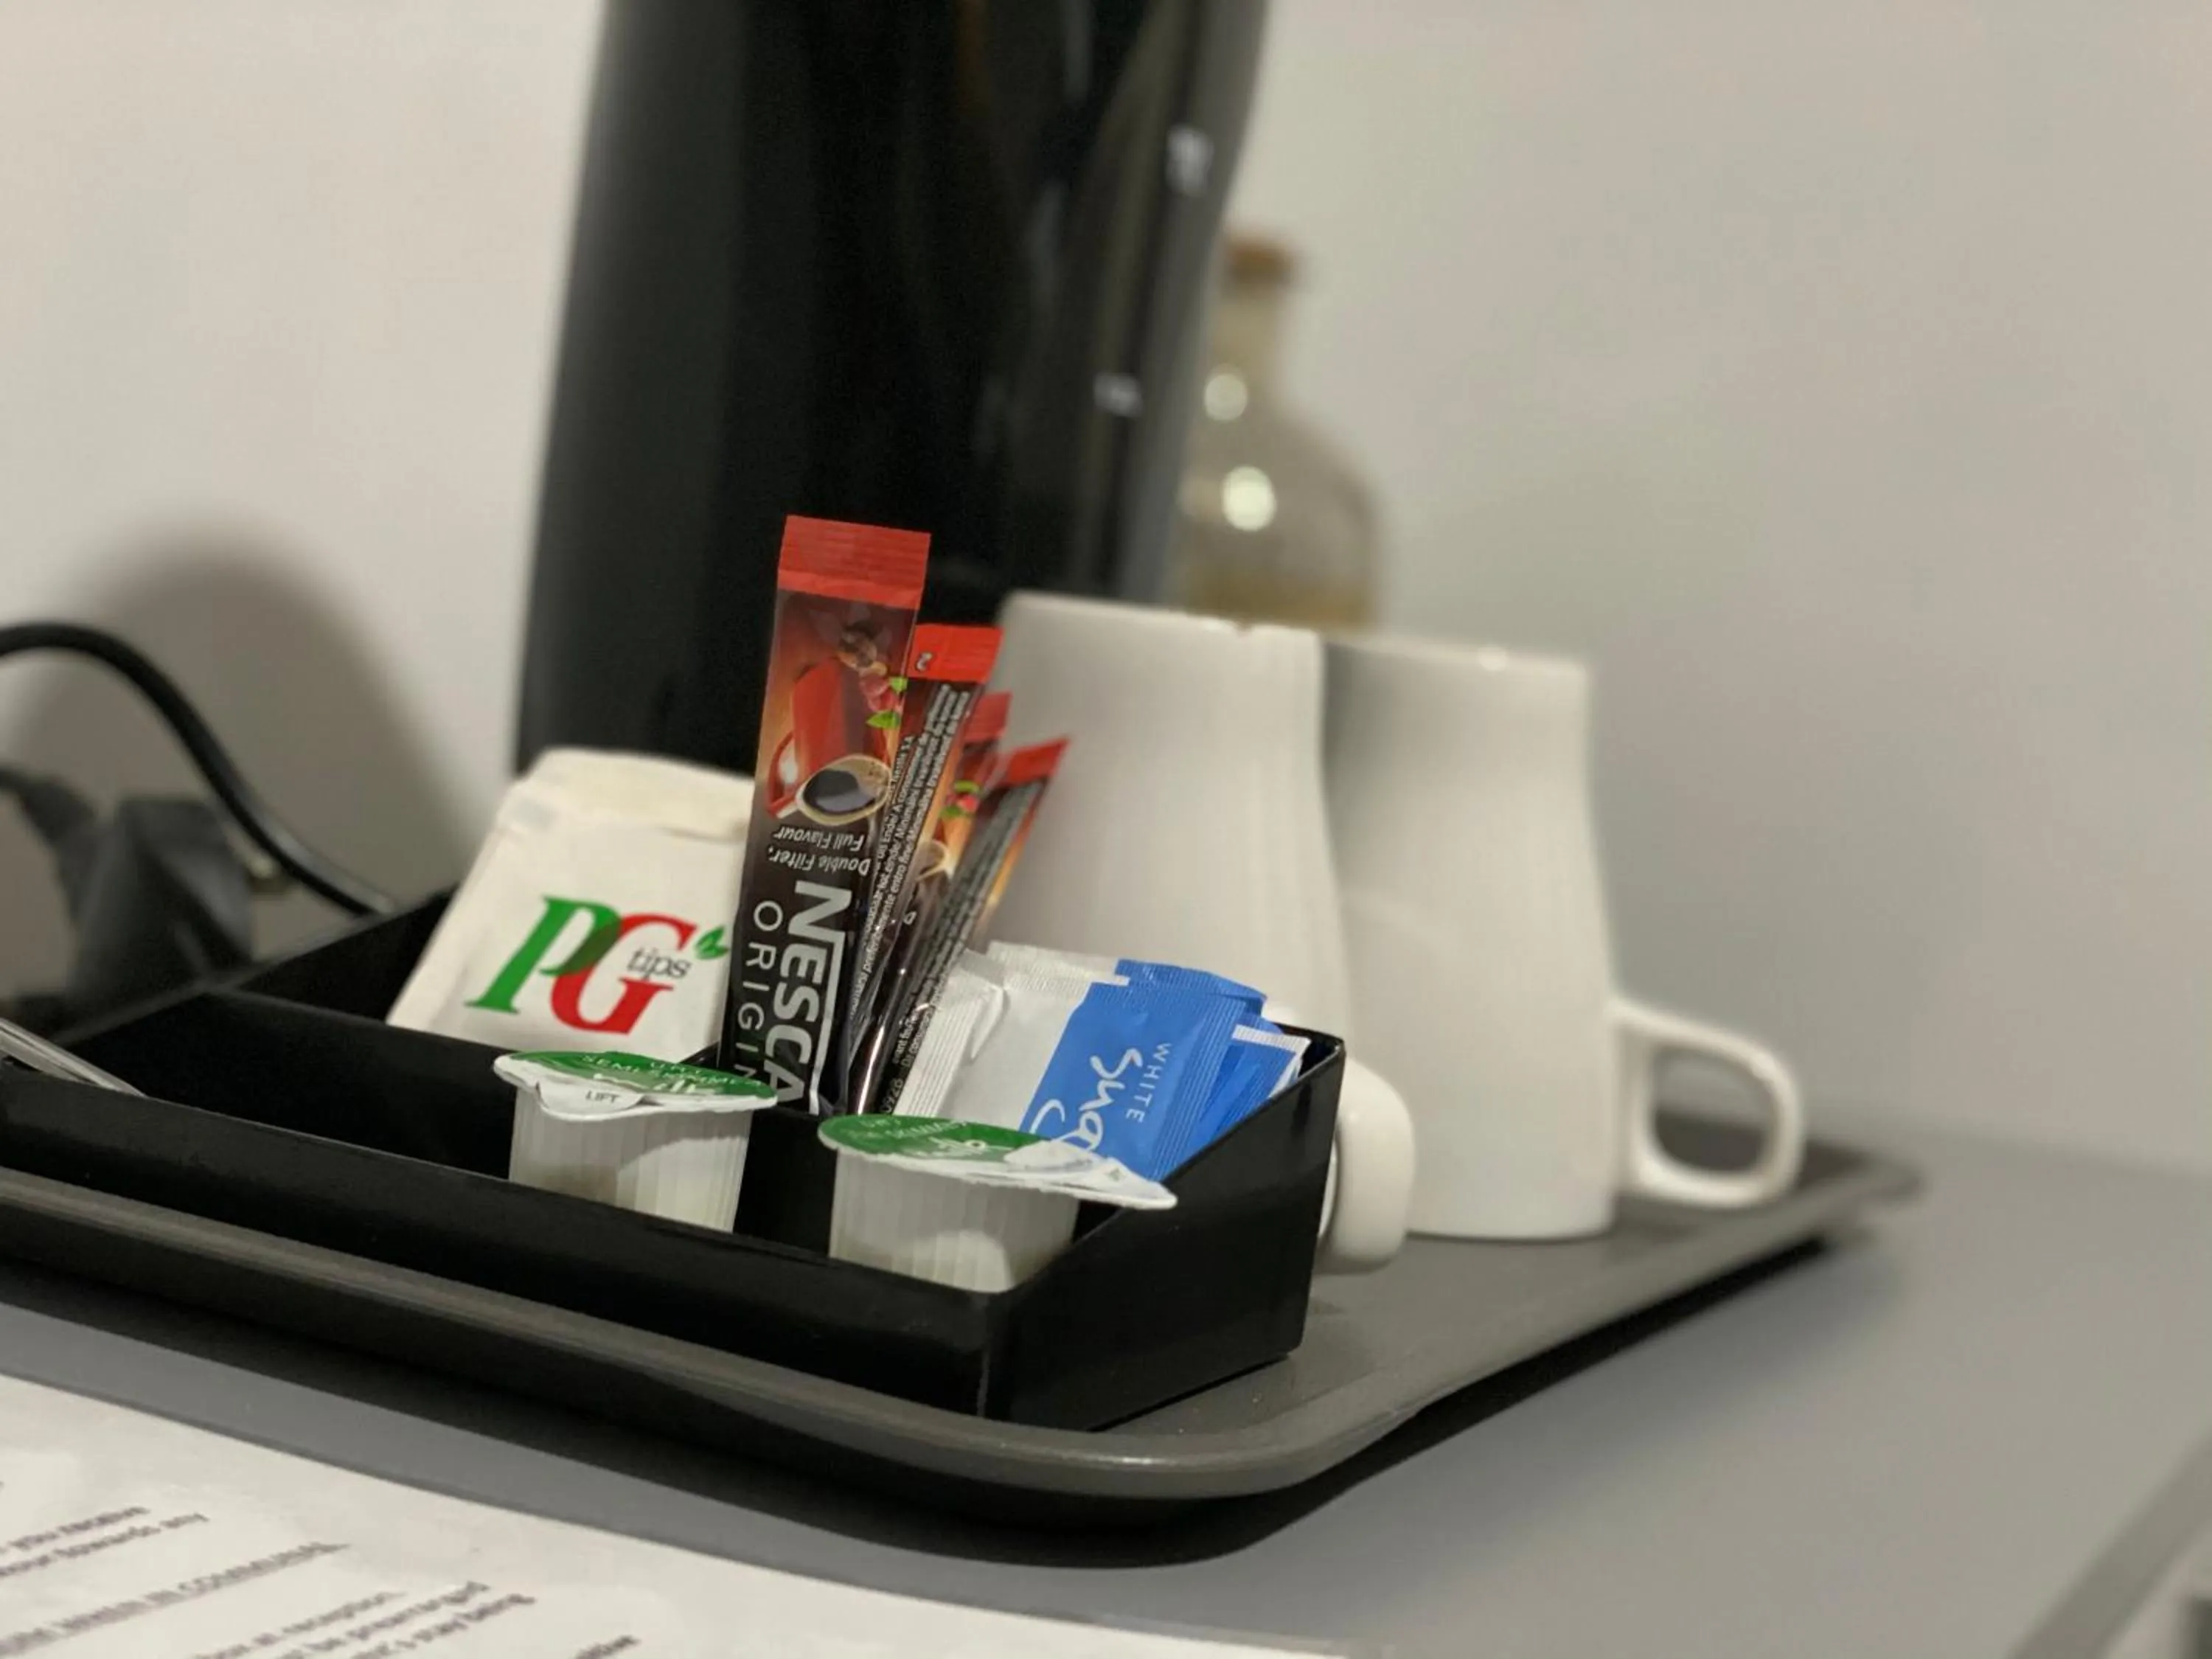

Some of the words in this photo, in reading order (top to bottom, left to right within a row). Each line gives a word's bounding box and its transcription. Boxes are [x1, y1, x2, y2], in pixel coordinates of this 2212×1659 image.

[773, 826, 831, 849] Flavour
[833, 832, 865, 852] Full
[818, 855, 872, 877] Double
[464, 895, 698, 1035] PG
[627, 946, 692, 979] tips
[1125, 1043, 1172, 1123] WHITE
[585, 1090, 620, 1103] LIFT
